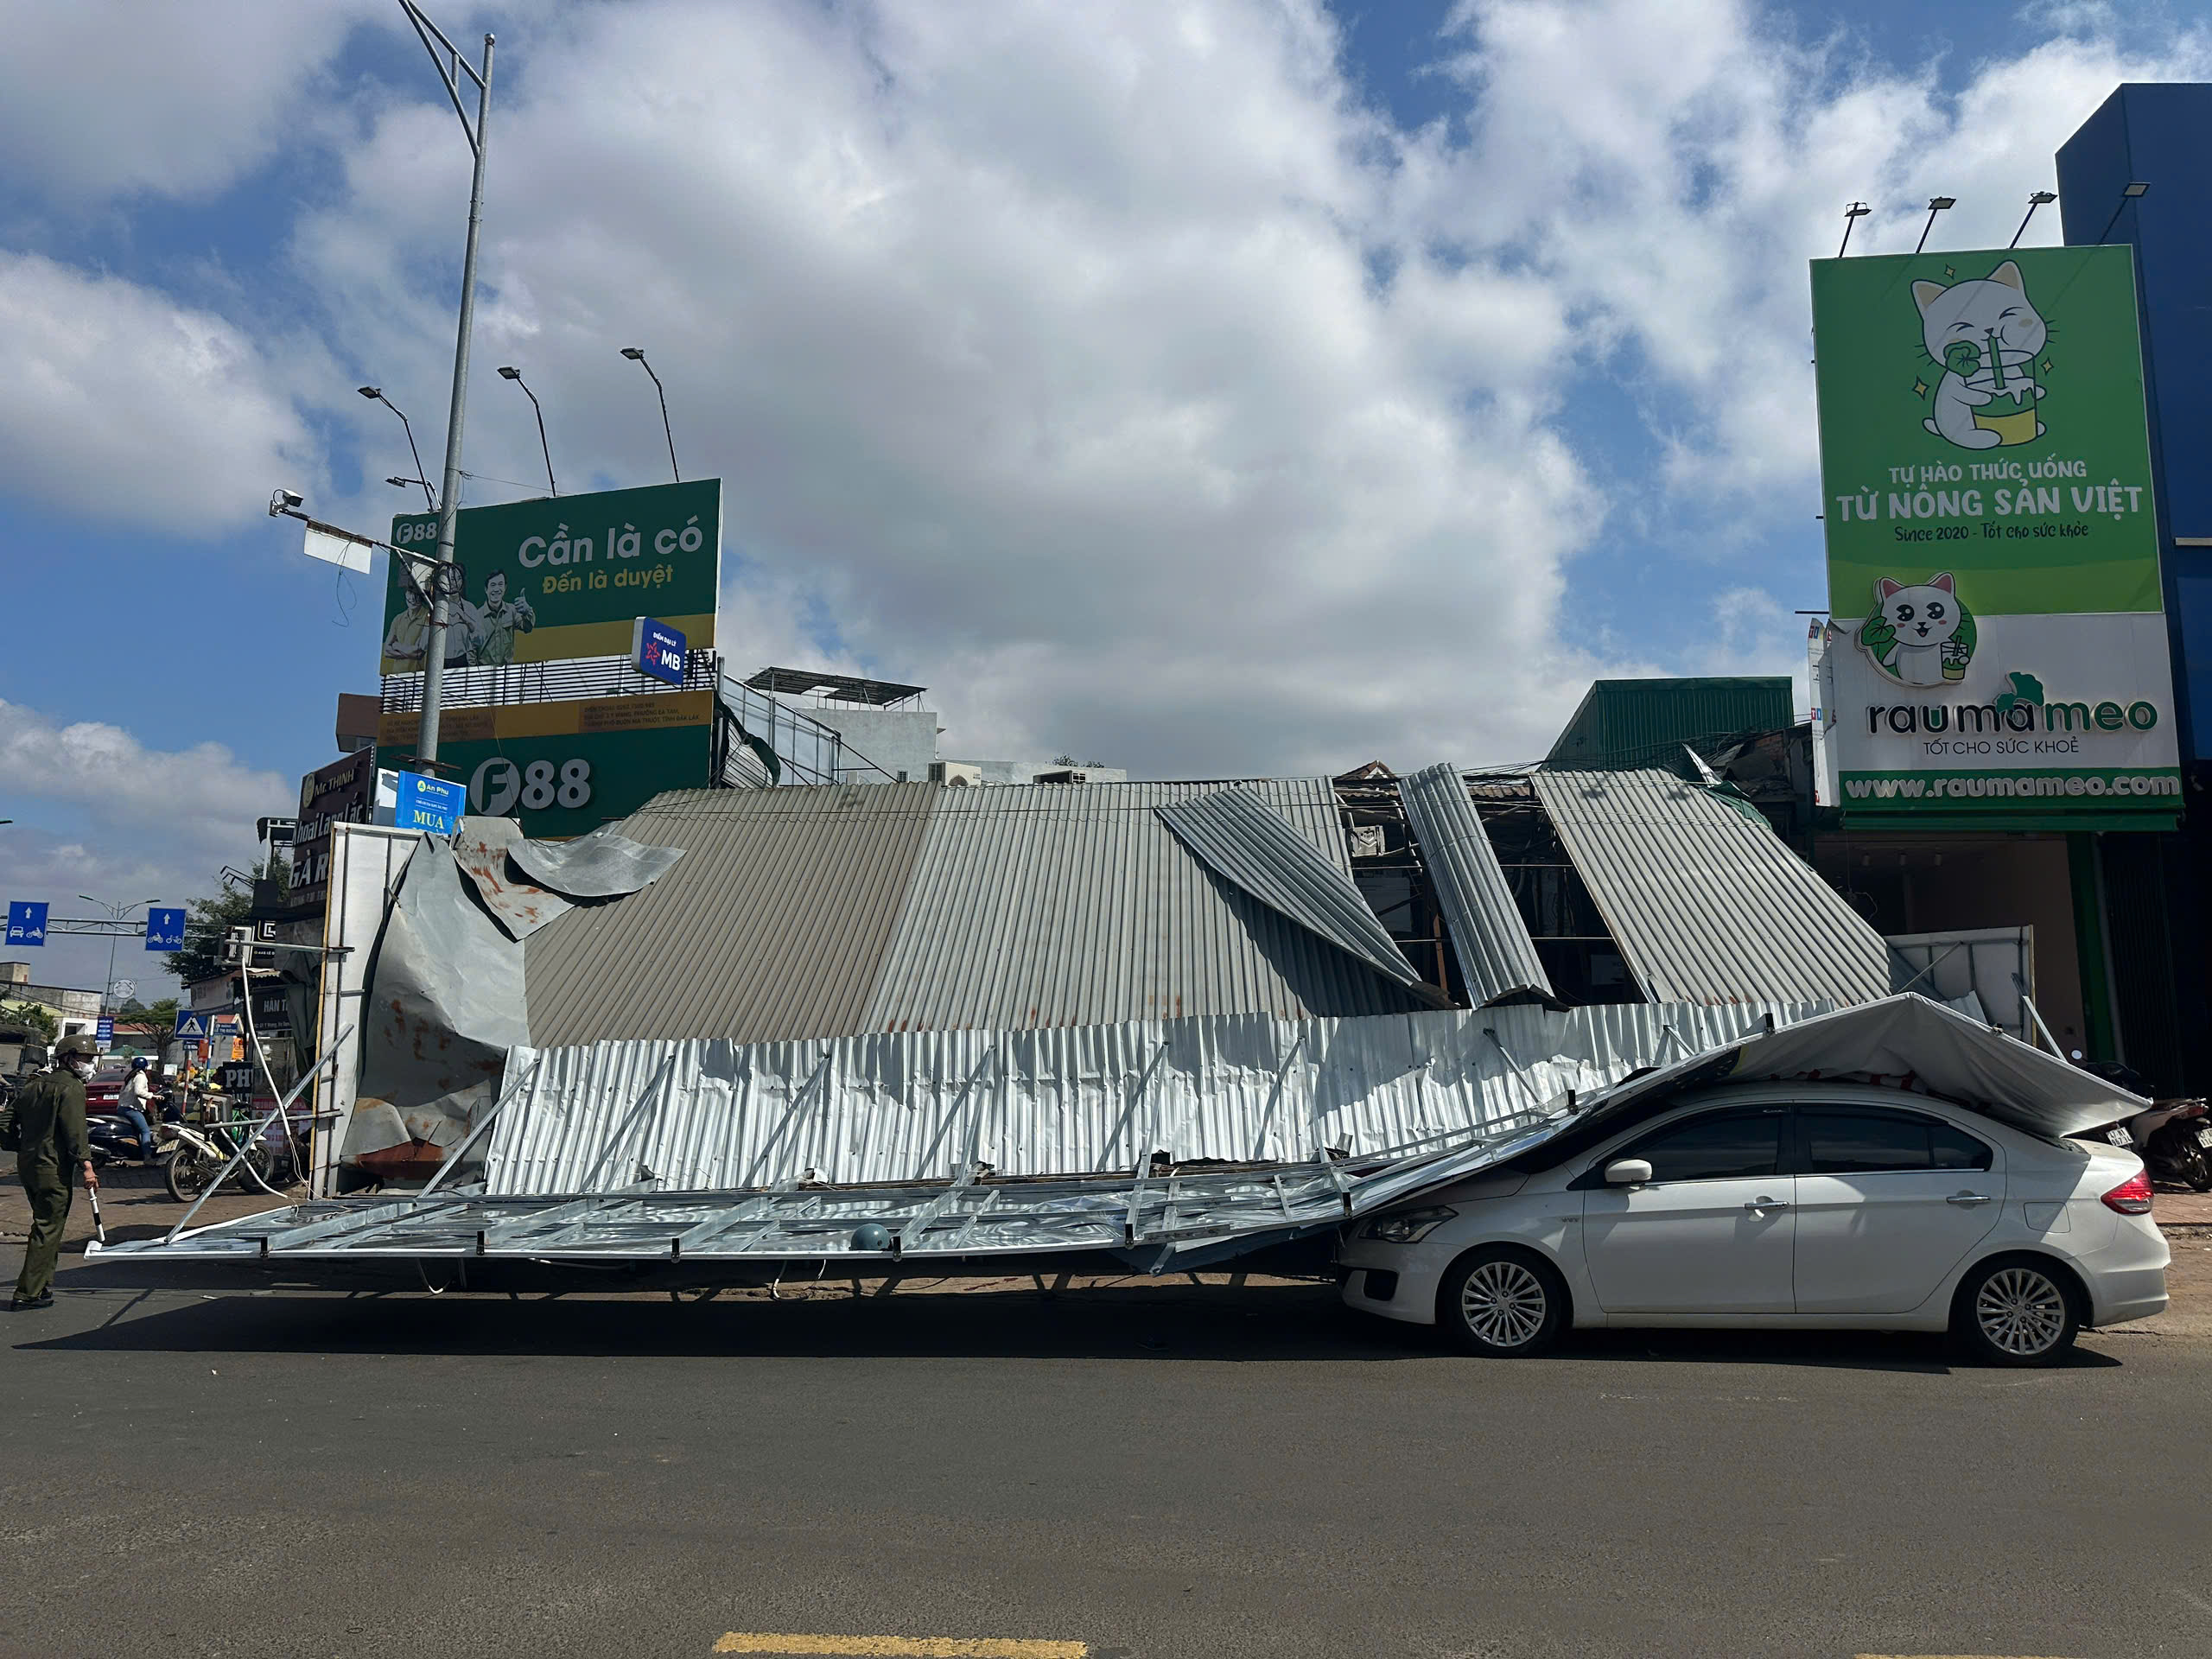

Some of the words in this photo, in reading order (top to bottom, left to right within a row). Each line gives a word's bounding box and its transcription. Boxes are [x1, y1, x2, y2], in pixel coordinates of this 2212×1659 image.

[1889, 466, 1915, 488] TỰ
[1920, 460, 1963, 483] HÀO
[1969, 459, 2023, 480] THỨC
[2029, 453, 2088, 478] UỐNG
[1836, 485, 1879, 522] TỪ
[1888, 482, 1984, 520] NÔNG
[1994, 478, 2061, 517] SẢN
[2070, 478, 2143, 521] VIỆT
[396, 522, 438, 544] F88
[518, 522, 594, 569] Cần
[607, 522, 642, 561] là
[654, 514, 703, 555] có
[1895, 525, 1934, 543] Since
[1936, 525, 1969, 541] 2020
[1980, 521, 2003, 540] Tốt
[2006, 525, 2029, 540] cho
[2033, 521, 2056, 538] sức
[2059, 520, 2089, 537] khỏe
[543, 569, 582, 594] Đến
[589, 569, 608, 589] là
[614, 563, 673, 588] duyệt
[661, 649, 681, 671] MB
[1867, 698, 2158, 734] raumameo
[1923, 738, 1949, 755] TỐT
[1952, 741, 1991, 754] CHO
[1997, 738, 2030, 754] SỨC
[2034, 735, 2080, 753] KHOẺ
[328, 768, 355, 792] THỊNH
[427, 784, 435, 792] An
[469, 757, 591, 817] F88
[1844, 774, 2180, 799] www.raumameo.com
[412, 809, 445, 830] MUA
[288, 849, 312, 890] GÀ
[314, 851, 329, 883] R
